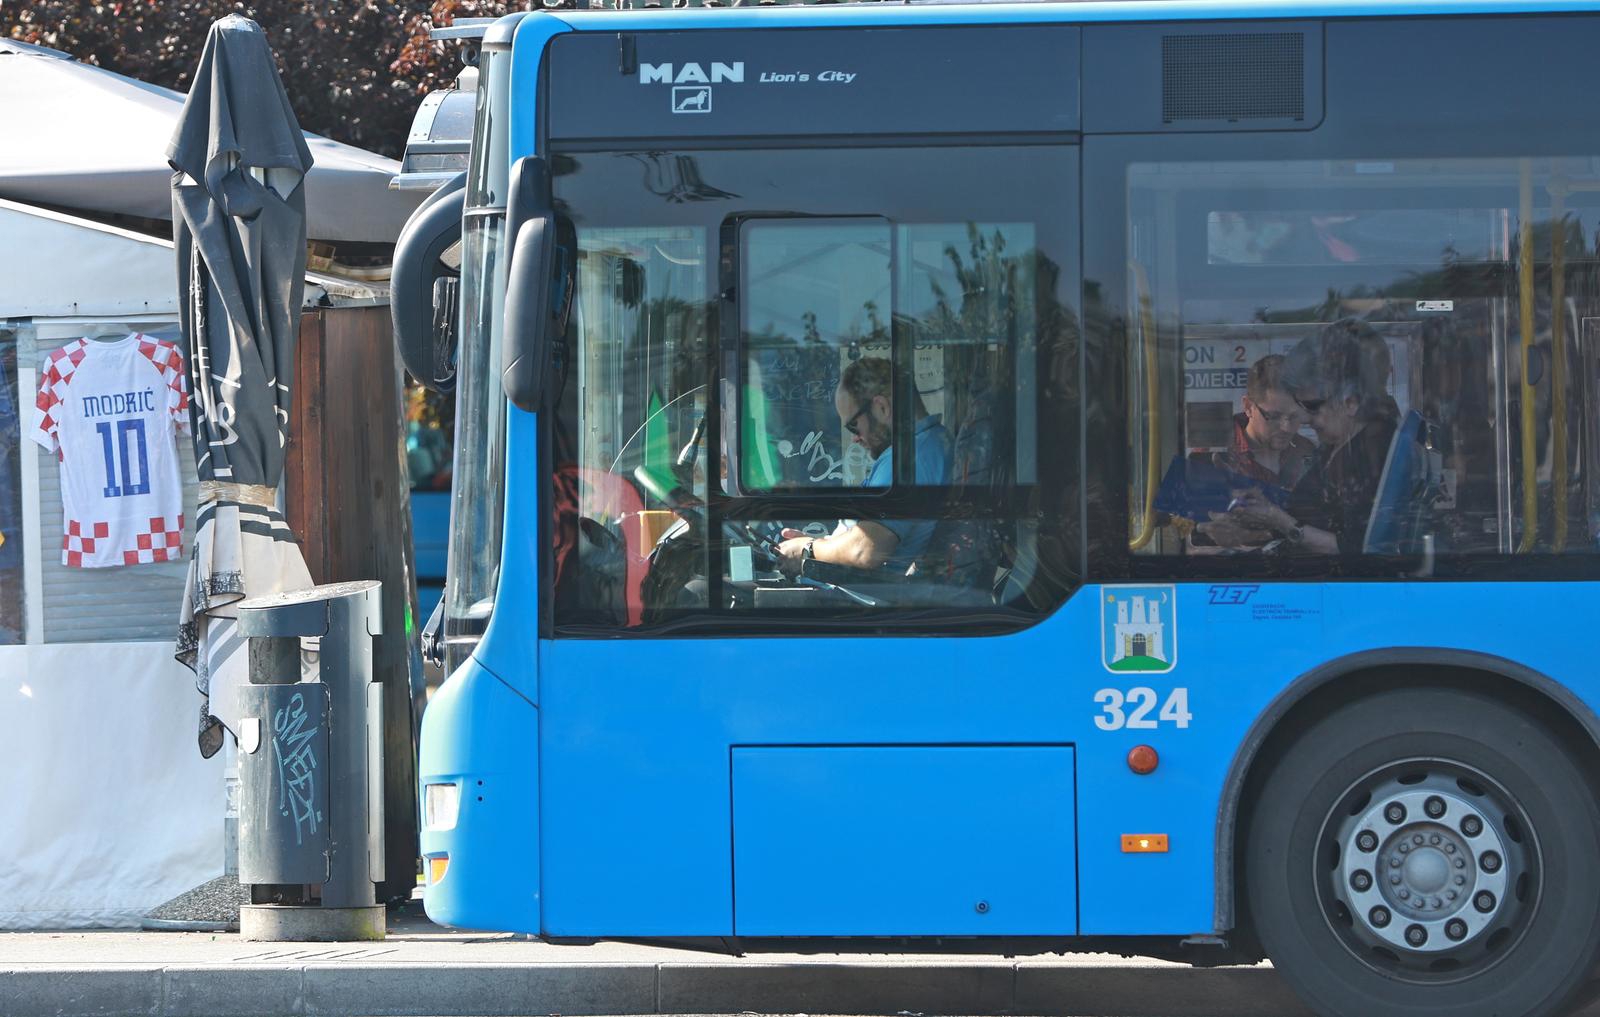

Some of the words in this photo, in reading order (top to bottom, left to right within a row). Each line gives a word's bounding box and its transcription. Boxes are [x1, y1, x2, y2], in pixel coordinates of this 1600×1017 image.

[640, 61, 744, 84] MAN
[759, 71, 809, 83] Lion's
[817, 70, 856, 84] City
[1234, 345, 1247, 362] 2
[82, 386, 155, 418] MODRIĆ
[96, 418, 151, 498] 10
[1208, 585, 1260, 605] ZET
[1093, 687, 1192, 731] 324
